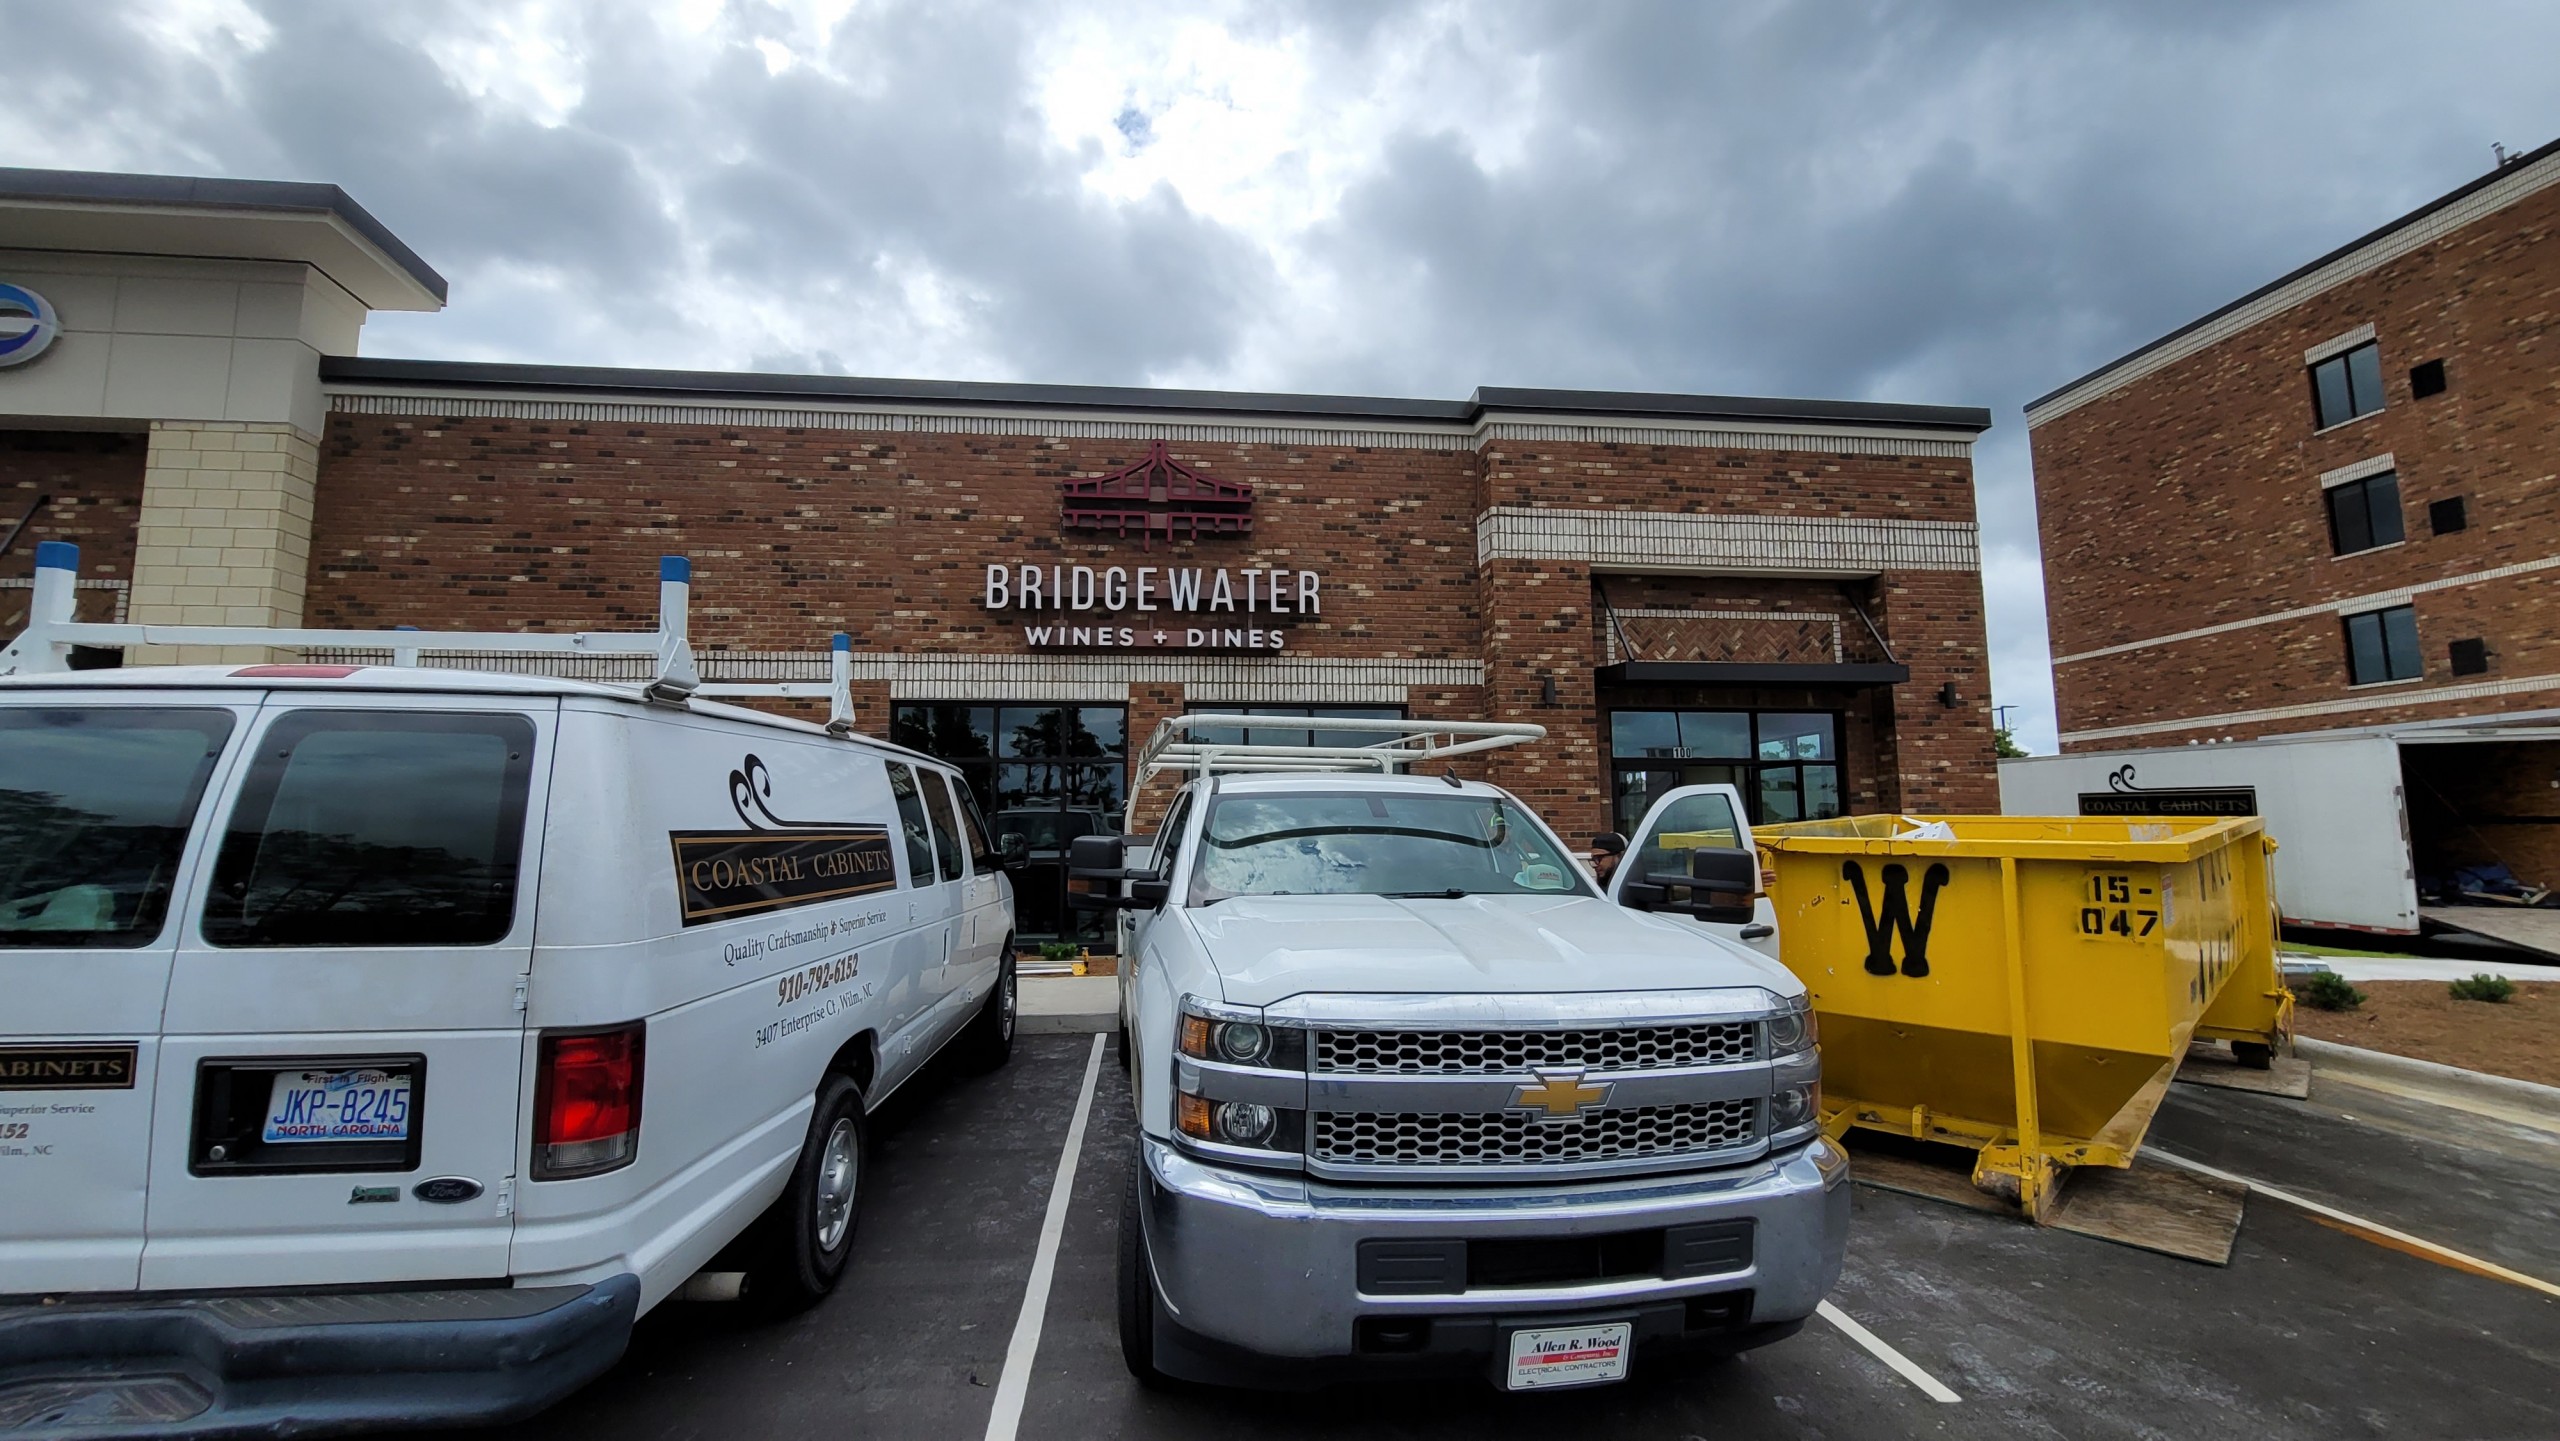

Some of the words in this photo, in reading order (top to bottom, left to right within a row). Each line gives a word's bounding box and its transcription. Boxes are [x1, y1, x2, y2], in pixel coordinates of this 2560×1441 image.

[986, 564, 1321, 614] BRIDGEWATER
[1024, 626, 1134, 647] WINES
[1187, 629, 1285, 649] DINES
[1674, 747, 1692, 758] 100
[2084, 800, 2150, 812] COASTAL
[2159, 800, 2249, 812] CABINETS
[692, 856, 806, 891] COASTAL
[814, 850, 890, 877] CABINETS
[2093, 875, 2152, 903] 15-
[1842, 860, 1950, 978] W
[2081, 908, 2158, 936] 047
[724, 938, 765, 966] Quality
[767, 922, 829, 952] Craftsmanship
[839, 914, 866, 936] Superior
[867, 910, 887, 925] Service
[778, 953, 859, 1007] 910-792-6152
[755, 1022, 778, 1049] 3407
[781, 1006, 825, 1037] Enterprise
[862, 982, 874, 1001] NC
[308, 1074, 334, 1084] First
[357, 1073, 389, 1084] Flight
[51, 1103, 95, 1114] Service
[273, 1088, 410, 1124] JKP-8245
[276, 1125, 327, 1136] NORTH
[332, 1124, 400, 1135] CAROLINA
[33, 1144, 53, 1155] NC
[428, 1182, 464, 1197] Ford
[1531, 1341, 1566, 1353] Allen
[1569, 1339, 1582, 1350] R.
[1588, 1335, 1621, 1349] Wood
[1518, 1366, 1561, 1376] ELECTRICAL
[1564, 1360, 1616, 1371] CONTRACTORS
